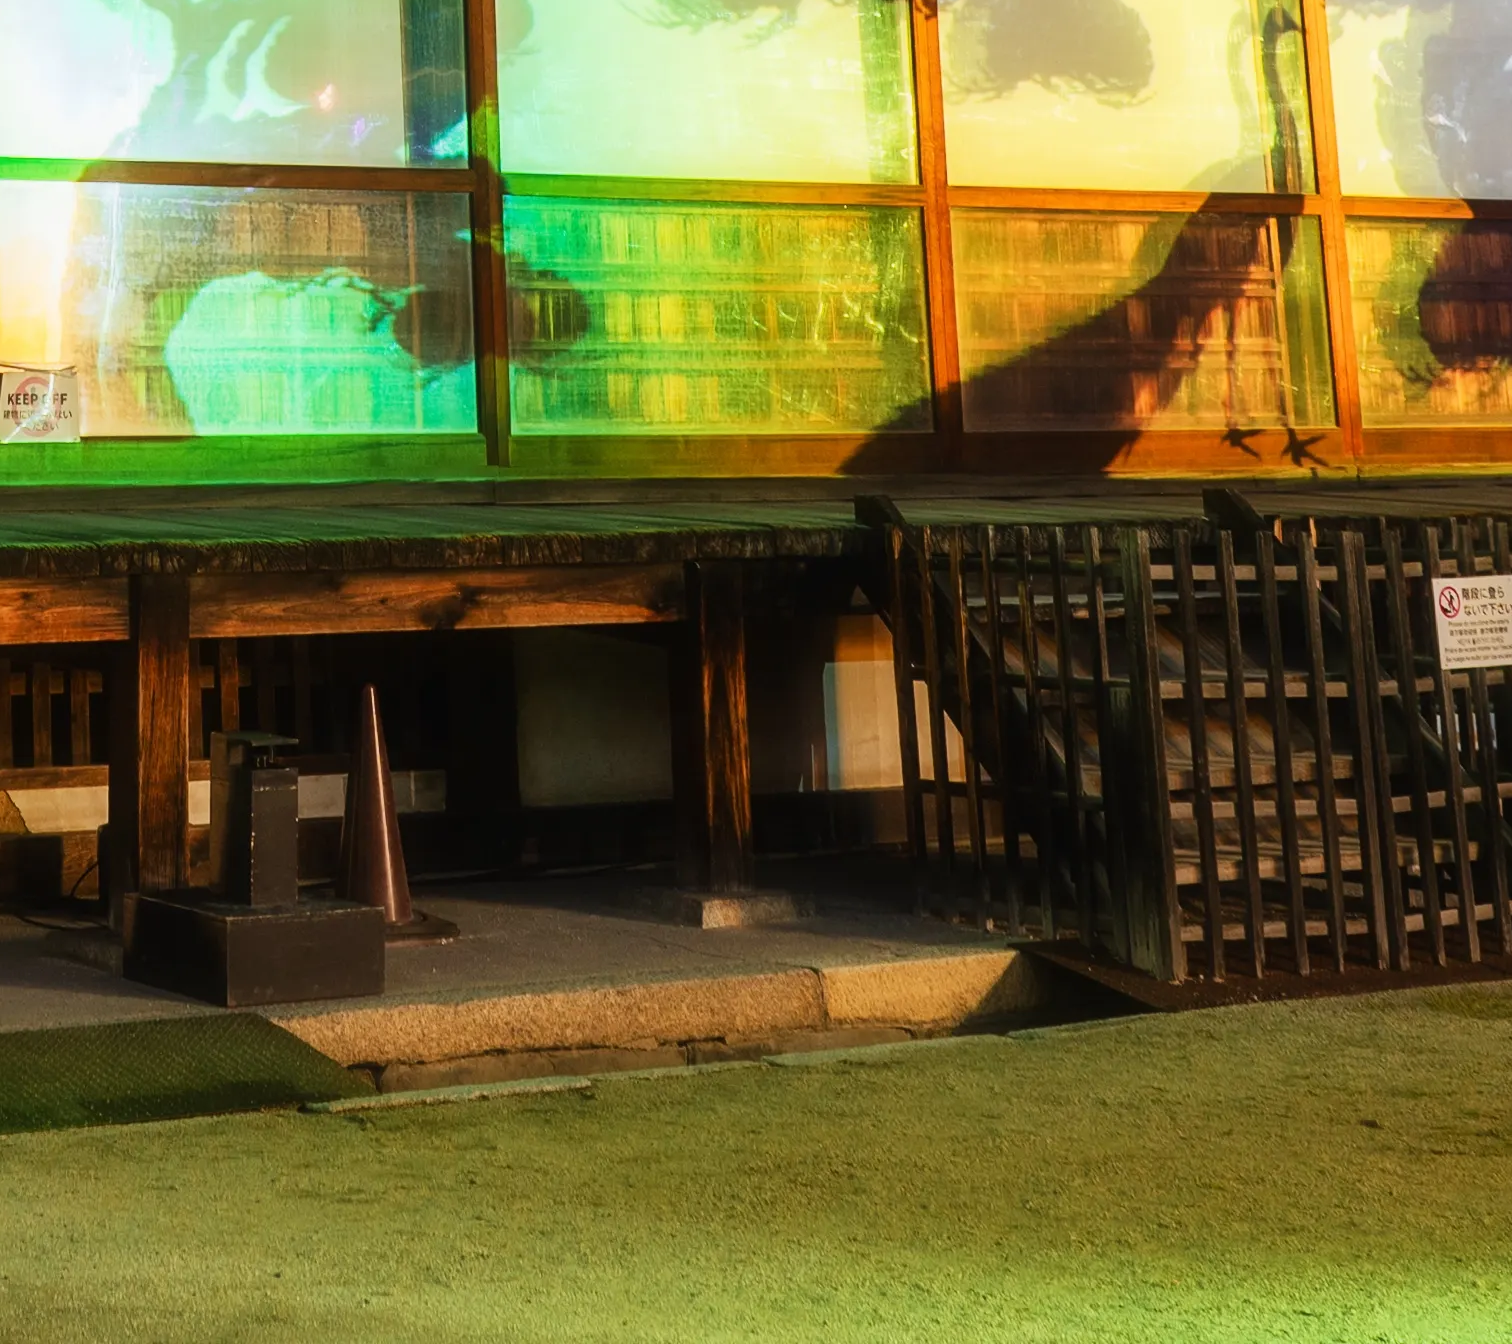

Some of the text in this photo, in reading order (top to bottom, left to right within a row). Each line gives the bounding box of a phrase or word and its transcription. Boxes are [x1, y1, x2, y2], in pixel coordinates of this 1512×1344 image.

[7, 393, 38, 405] KEEP
[1461, 586, 1505, 600] 階段に登ら
